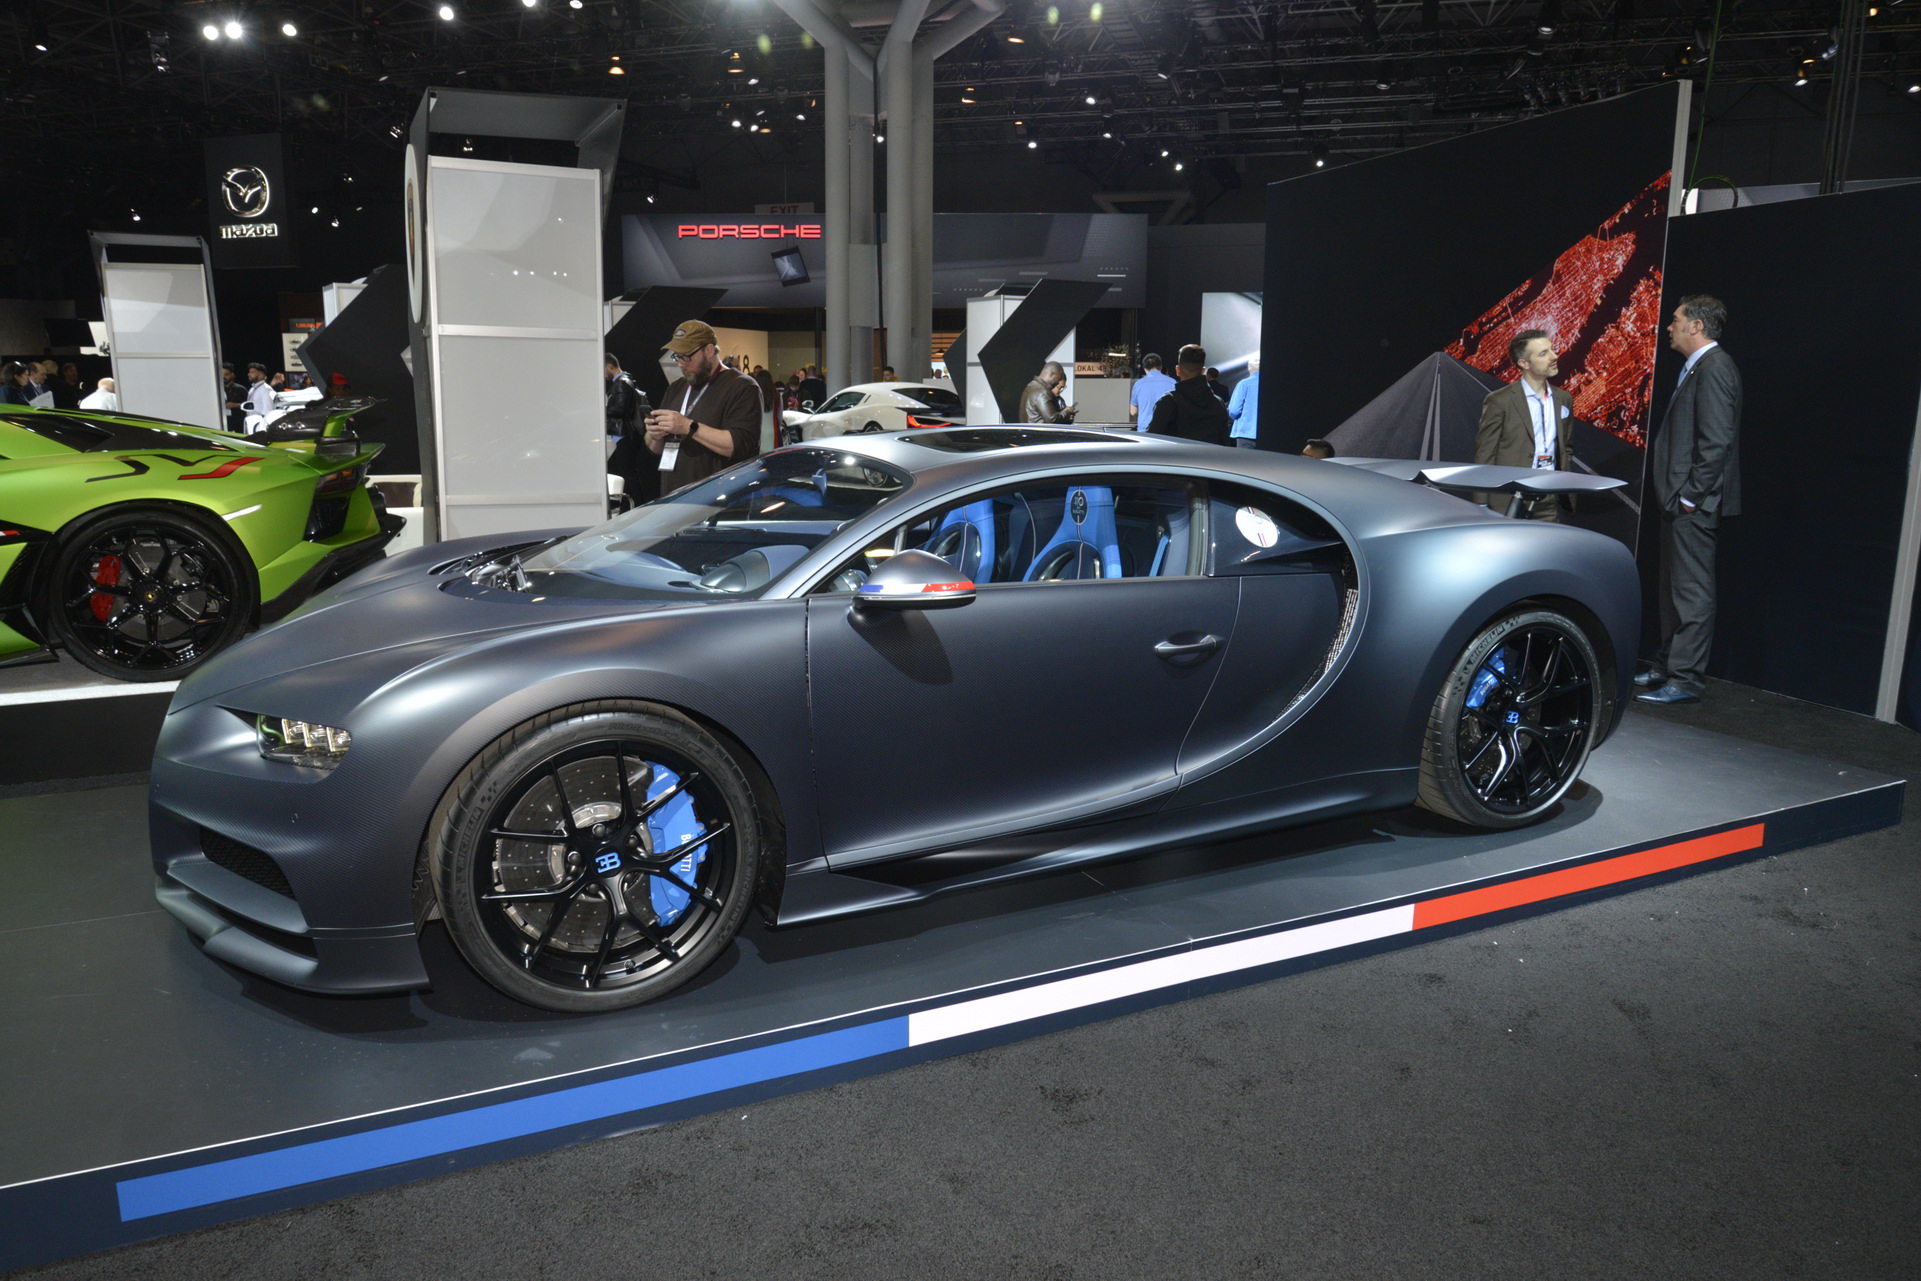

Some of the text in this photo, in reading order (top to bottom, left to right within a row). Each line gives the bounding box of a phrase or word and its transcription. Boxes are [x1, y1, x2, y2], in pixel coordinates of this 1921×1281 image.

[770, 205, 800, 214] EXIT
[678, 224, 821, 239] PORSCHE
[1074, 364, 1096, 372] OKAL
[1470, 624, 1506, 664] MICHELIN
[456, 806, 485, 869] MICHELIN
[680, 833, 693, 872] BTTI
